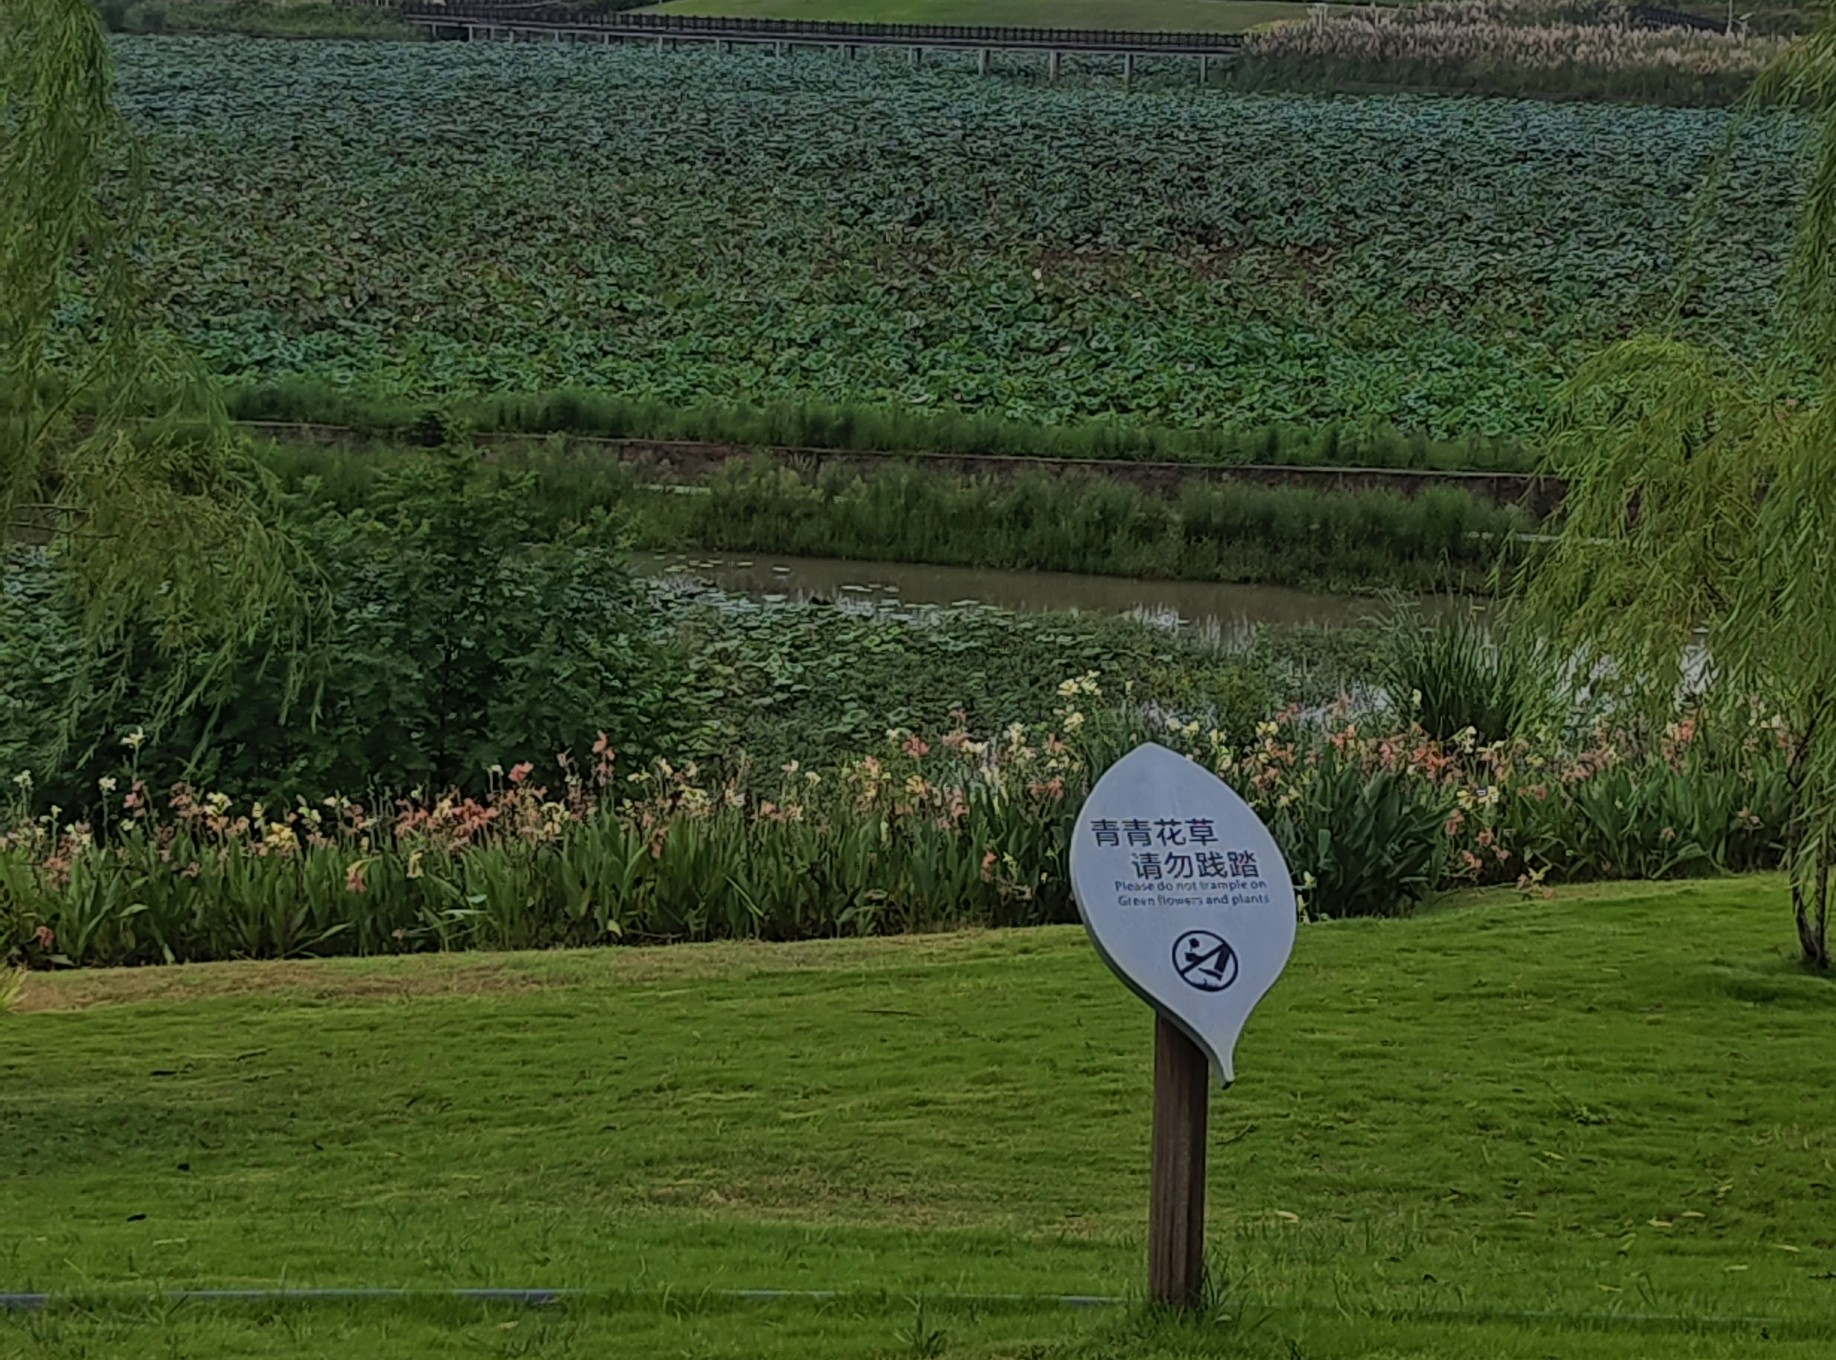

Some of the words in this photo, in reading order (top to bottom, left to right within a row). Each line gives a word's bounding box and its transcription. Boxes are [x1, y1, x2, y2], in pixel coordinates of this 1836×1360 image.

[1090, 818, 1219, 848] 青青花草
[1130, 850, 1259, 880] 请勿践踏
[1115, 880, 1155, 891] Please
[1157, 880, 1173, 891] do
[1176, 881, 1197, 891] not
[1201, 879, 1248, 892] trample
[1250, 880, 1267, 889] on
[1118, 895, 1156, 906] Green
[1157, 894, 1203, 906] flowers
[1206, 894, 1228, 905] and
[1231, 893, 1270, 906] plants
